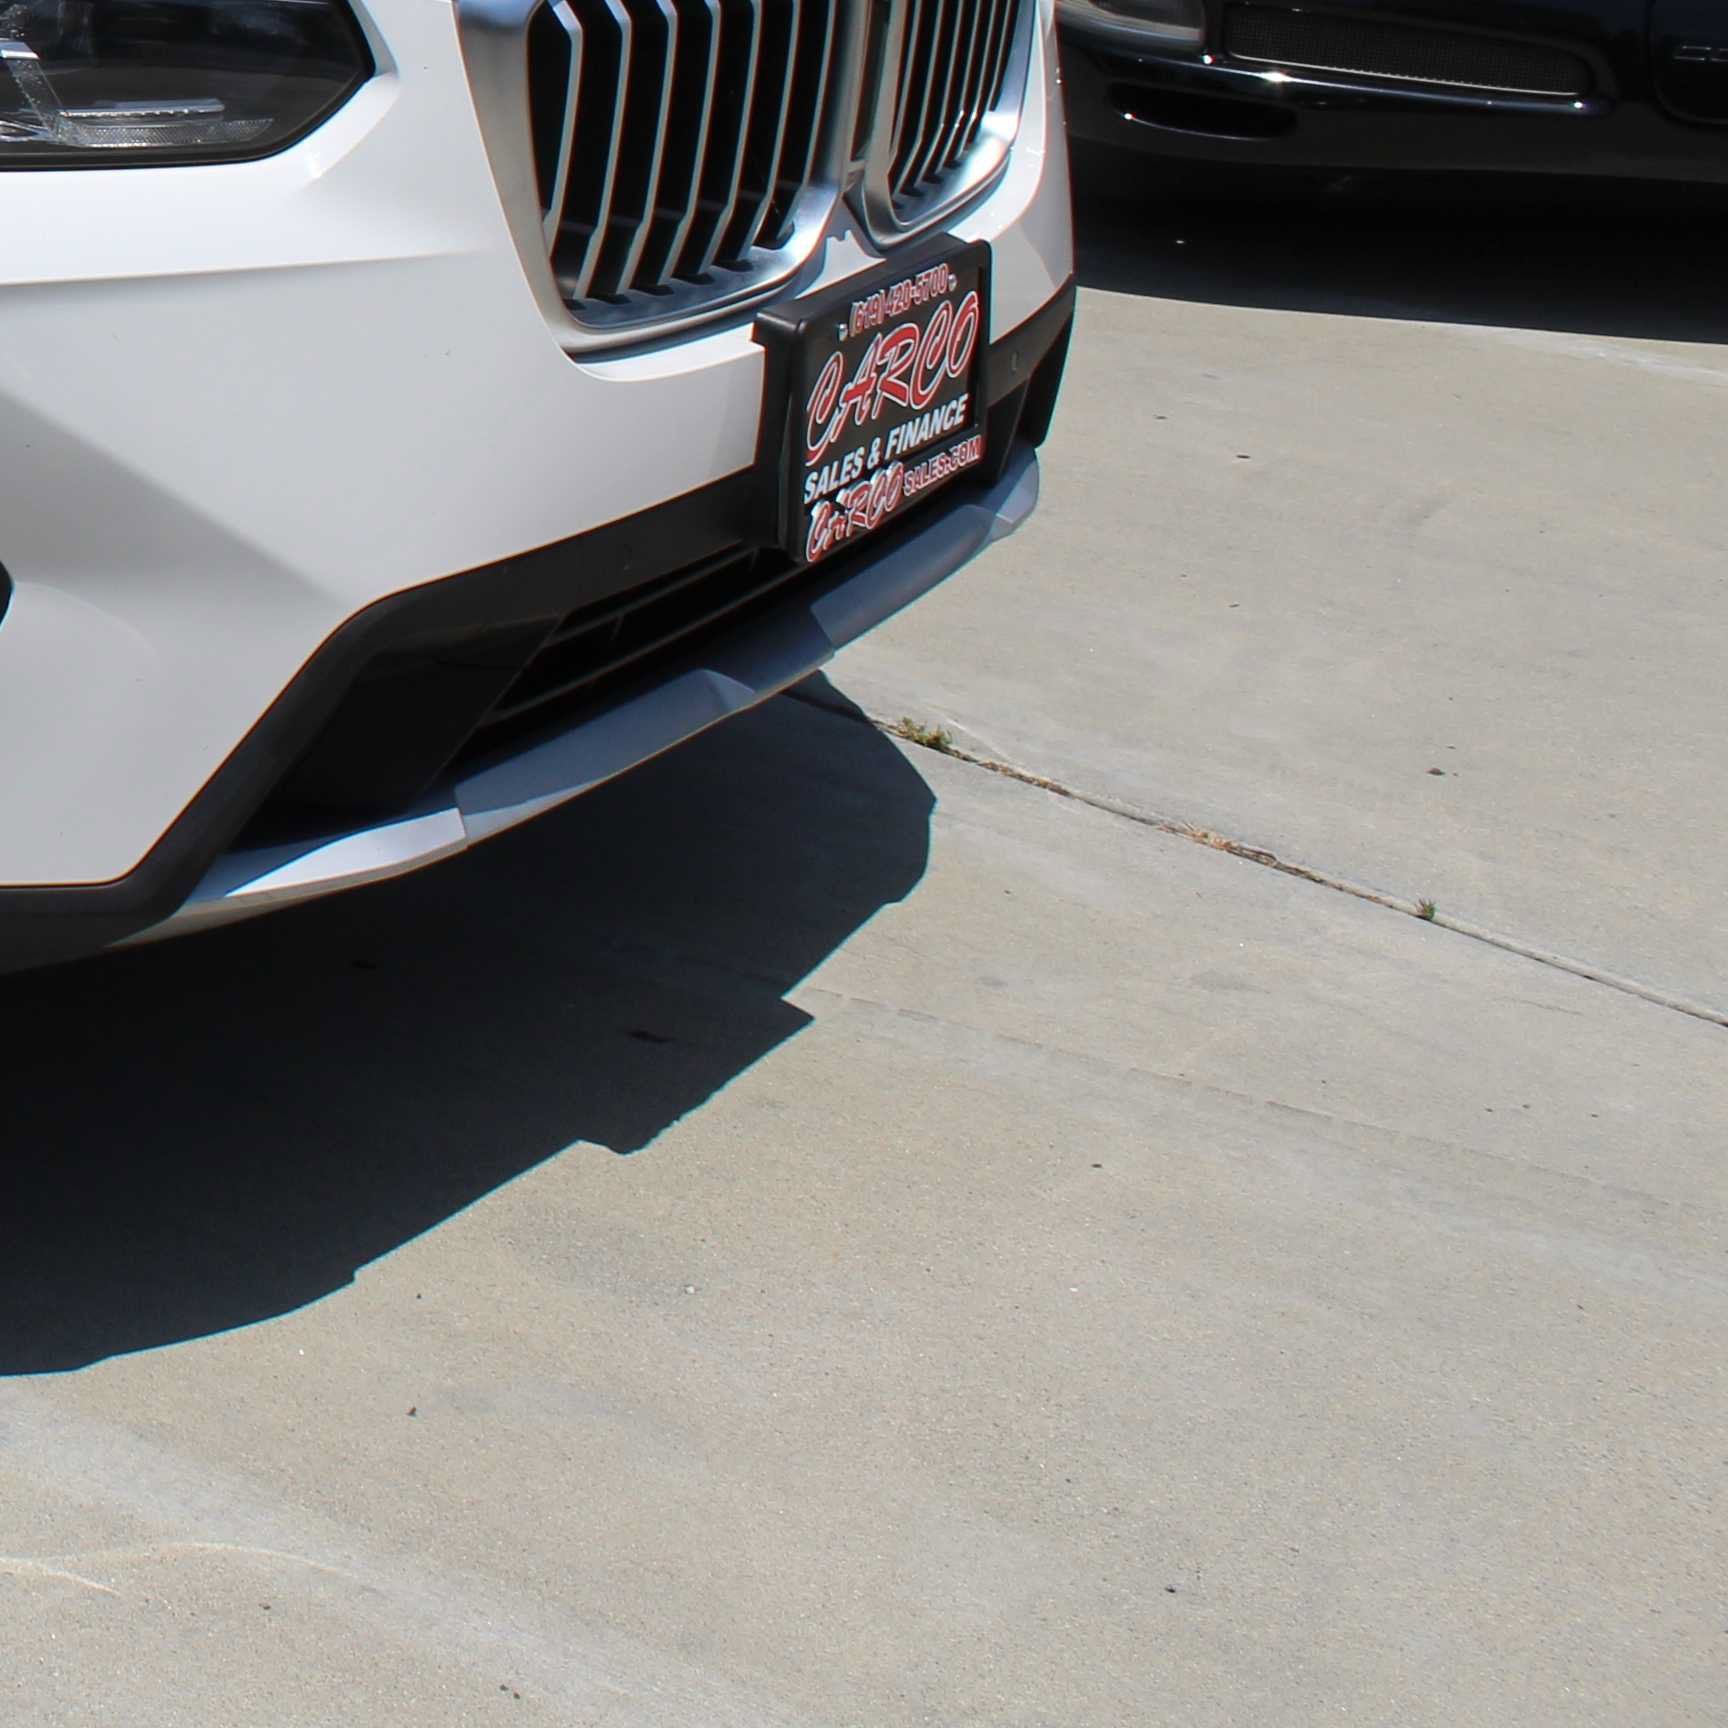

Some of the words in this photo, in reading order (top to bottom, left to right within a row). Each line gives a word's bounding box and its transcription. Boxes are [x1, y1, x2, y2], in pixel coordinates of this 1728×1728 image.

[803, 446, 865, 505] SALES
[867, 437, 881, 470] &
[884, 392, 969, 460] FINANCE
[805, 291, 979, 467] CARCO
